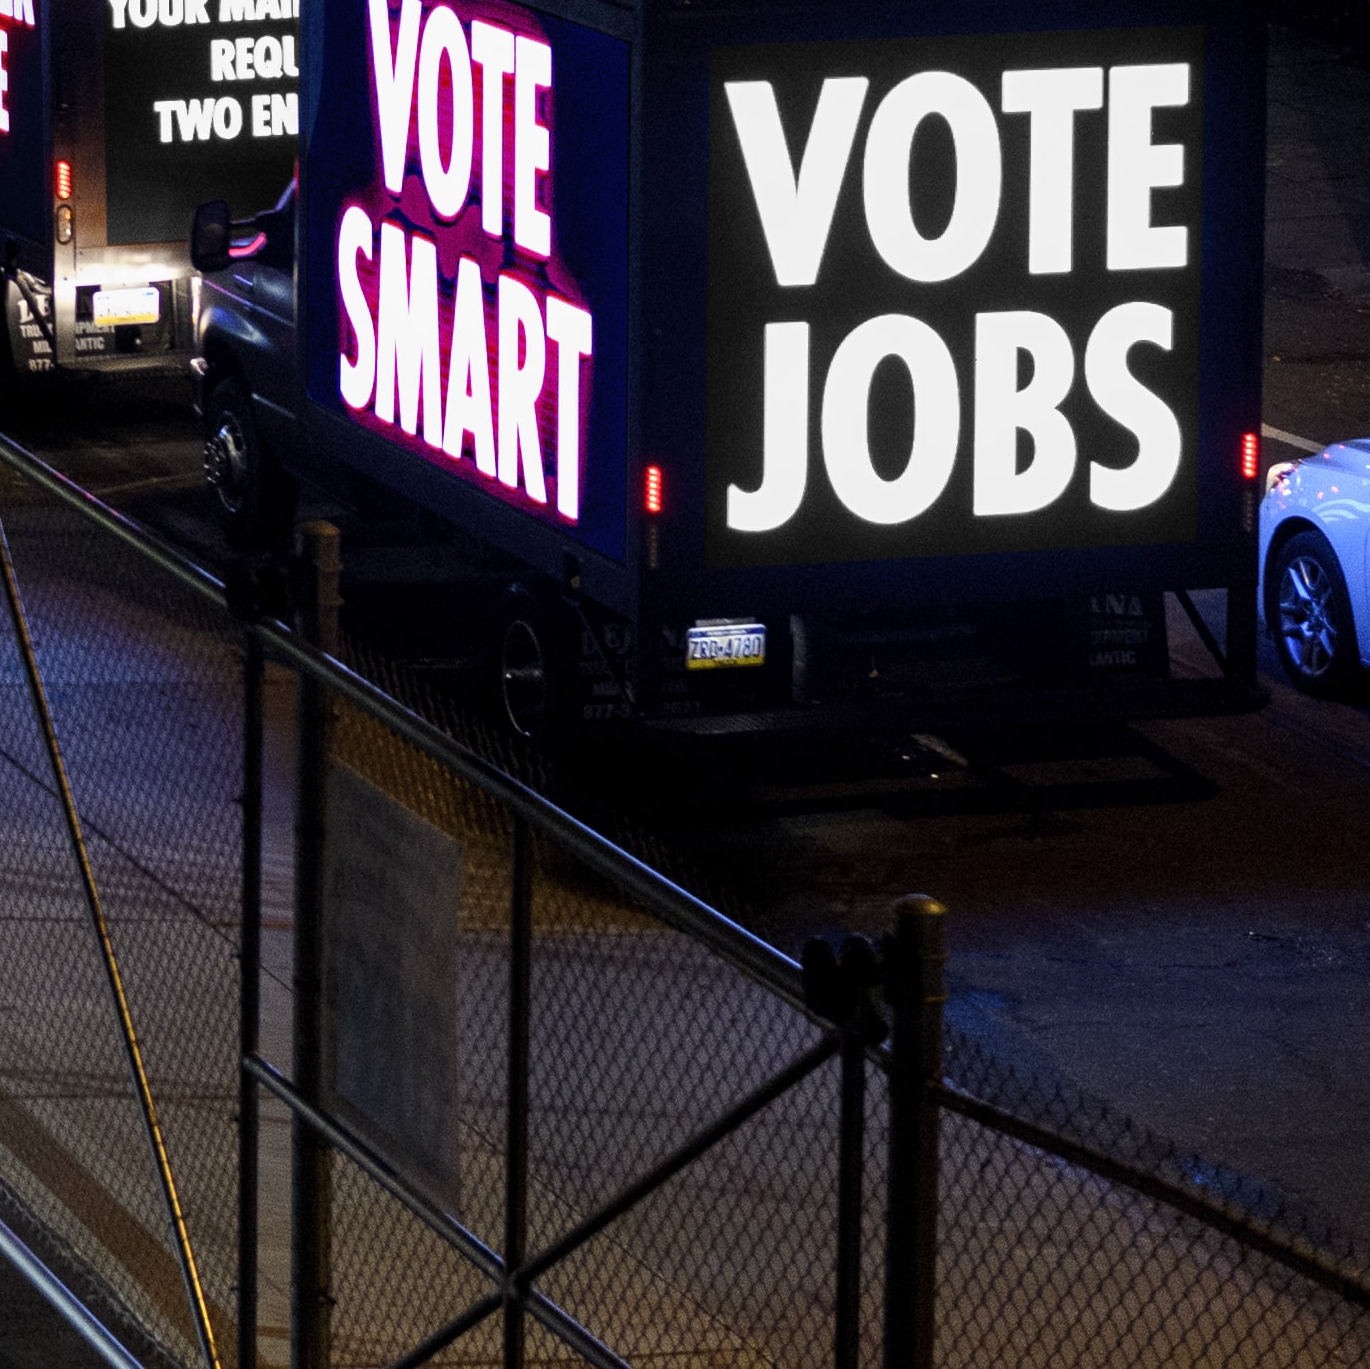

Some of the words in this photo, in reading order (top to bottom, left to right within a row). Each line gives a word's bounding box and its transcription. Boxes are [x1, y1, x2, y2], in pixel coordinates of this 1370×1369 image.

[153, 96, 244, 144] TWO
[251, 92, 300, 138] EN
[723, 62, 1191, 288] VOTE
[338, 206, 594, 520] SMART
[726, 301, 1183, 533] JOBS
